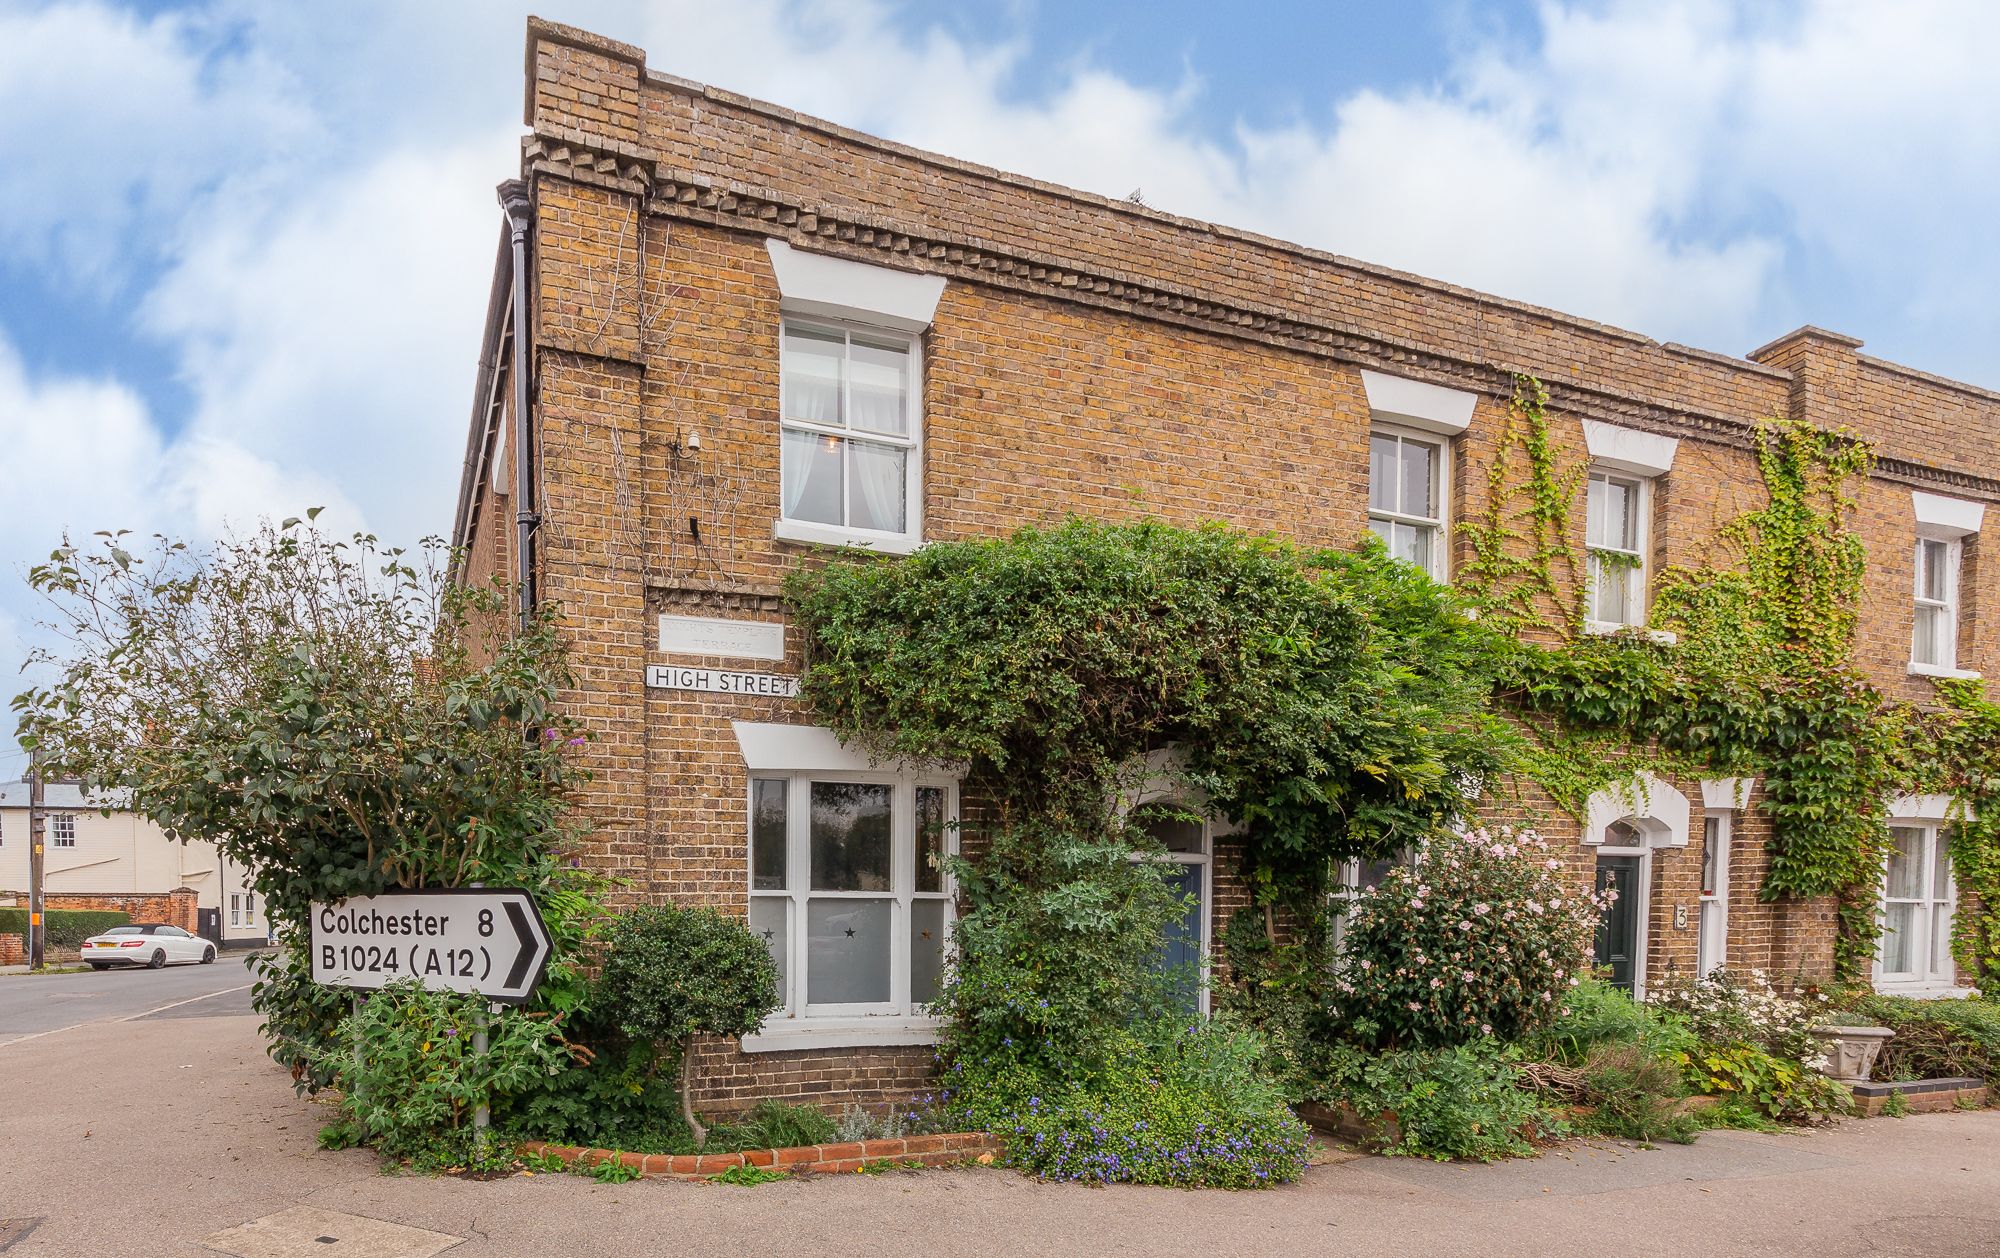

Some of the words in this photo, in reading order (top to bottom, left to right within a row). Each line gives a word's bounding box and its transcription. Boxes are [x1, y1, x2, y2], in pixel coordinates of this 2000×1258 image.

[655, 668, 709, 689] HIGH
[719, 673, 795, 695] STREET
[320, 908, 449, 936] Colchester
[477, 908, 494, 938] 8
[1678, 908, 1687, 926] 3
[322, 944, 399, 973] B1024
[409, 943, 492, 982] (A12)
